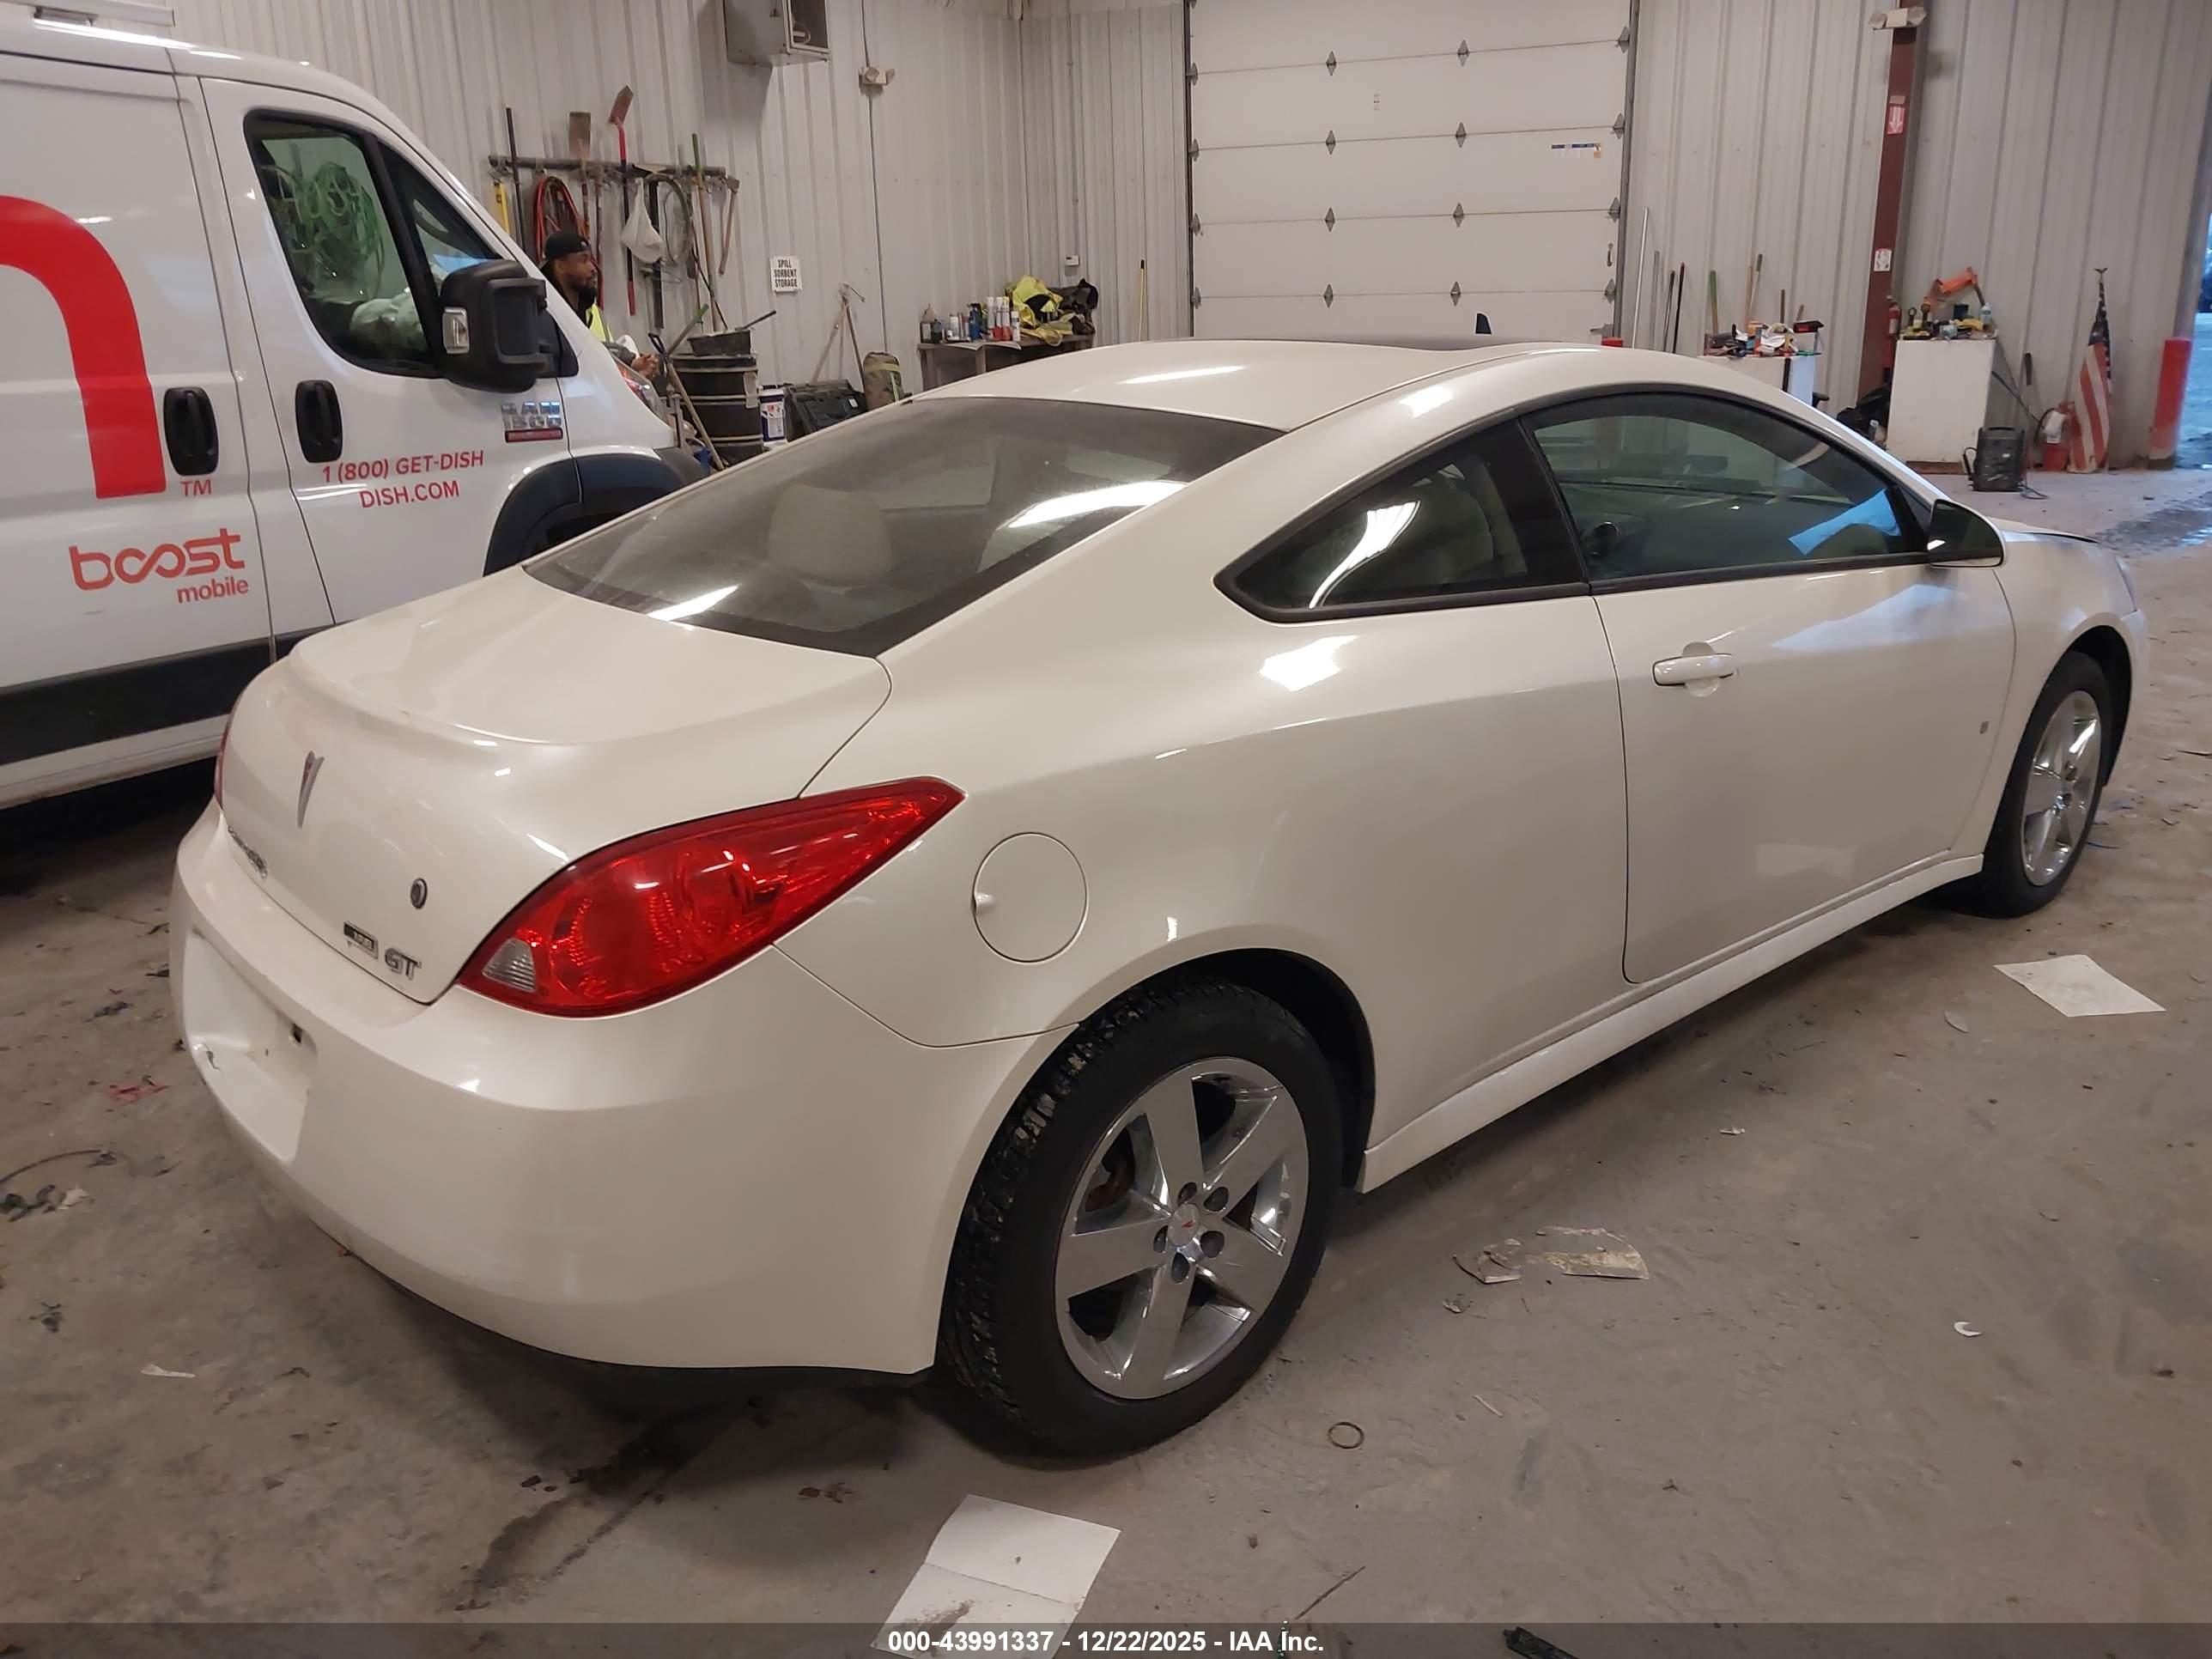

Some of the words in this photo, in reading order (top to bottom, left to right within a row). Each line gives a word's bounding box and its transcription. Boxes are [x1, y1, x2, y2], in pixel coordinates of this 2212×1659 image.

[774, 269, 797, 277] SORBENT
[778, 258, 792, 268] SPILL
[775, 278, 798, 288] STORAGE
[322, 466, 331, 483] 1
[337, 459, 389, 483] (800)
[395, 450, 484, 475] GET-DISH
[180, 479, 212, 496] TM
[360, 480, 459, 508] DISH.COM
[69, 528, 245, 591] boost
[177, 576, 249, 603] mobile
[384, 947, 422, 981] GT
